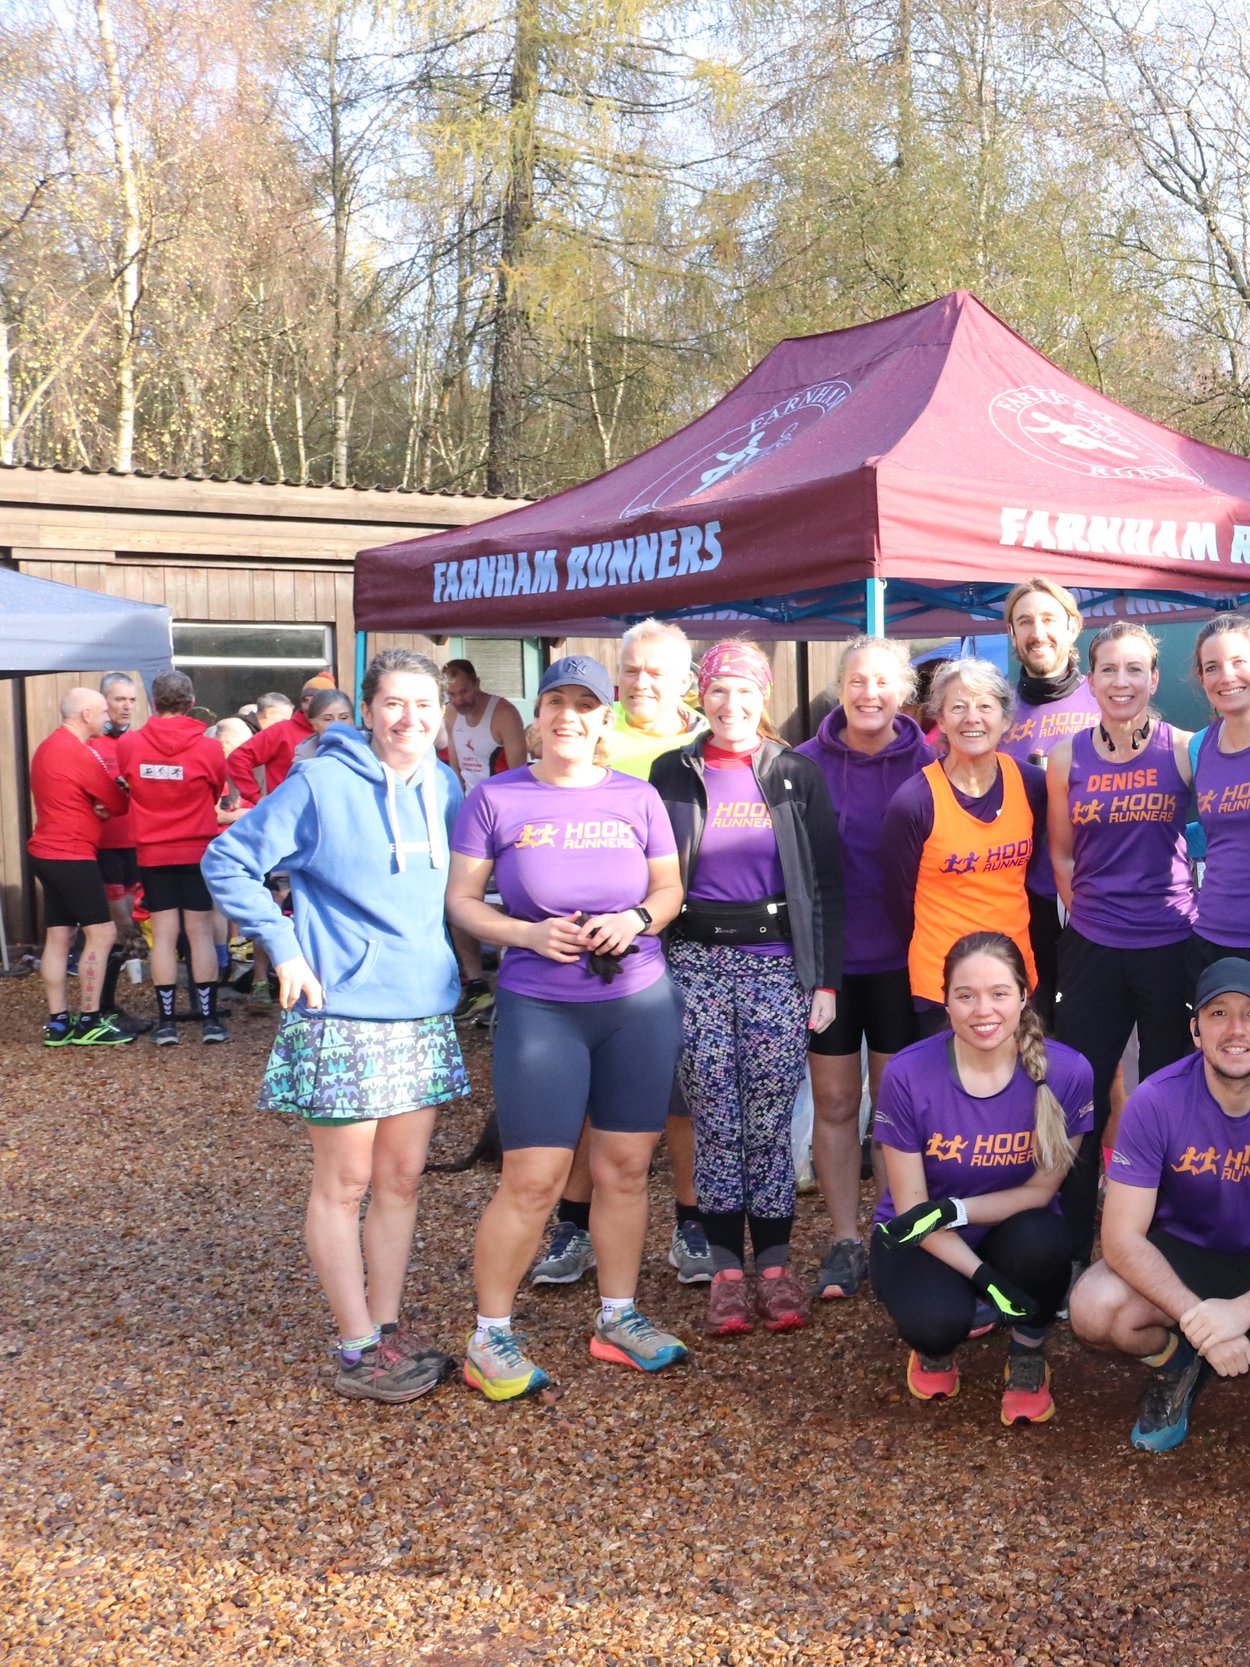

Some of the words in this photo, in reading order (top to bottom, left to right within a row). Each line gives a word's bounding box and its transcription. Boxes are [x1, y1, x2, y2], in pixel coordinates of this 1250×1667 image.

[1000, 506, 1219, 562] FARNHAM
[432, 549, 559, 603] FARNHAM
[565, 520, 723, 590] RUNNERS
[1041, 711, 1100, 729] HOOK
[1086, 768, 1158, 793] DENISE
[714, 801, 771, 818] HOO
[1110, 793, 1177, 812] HOOK
[711, 817, 772, 828] RUNNER
[1108, 810, 1175, 823] RUNNERS
[564, 821, 636, 840] HOOK
[562, 837, 636, 849] RUNNERS
[973, 1131, 1034, 1154] HOO
[970, 1150, 1034, 1167] RUNNER
